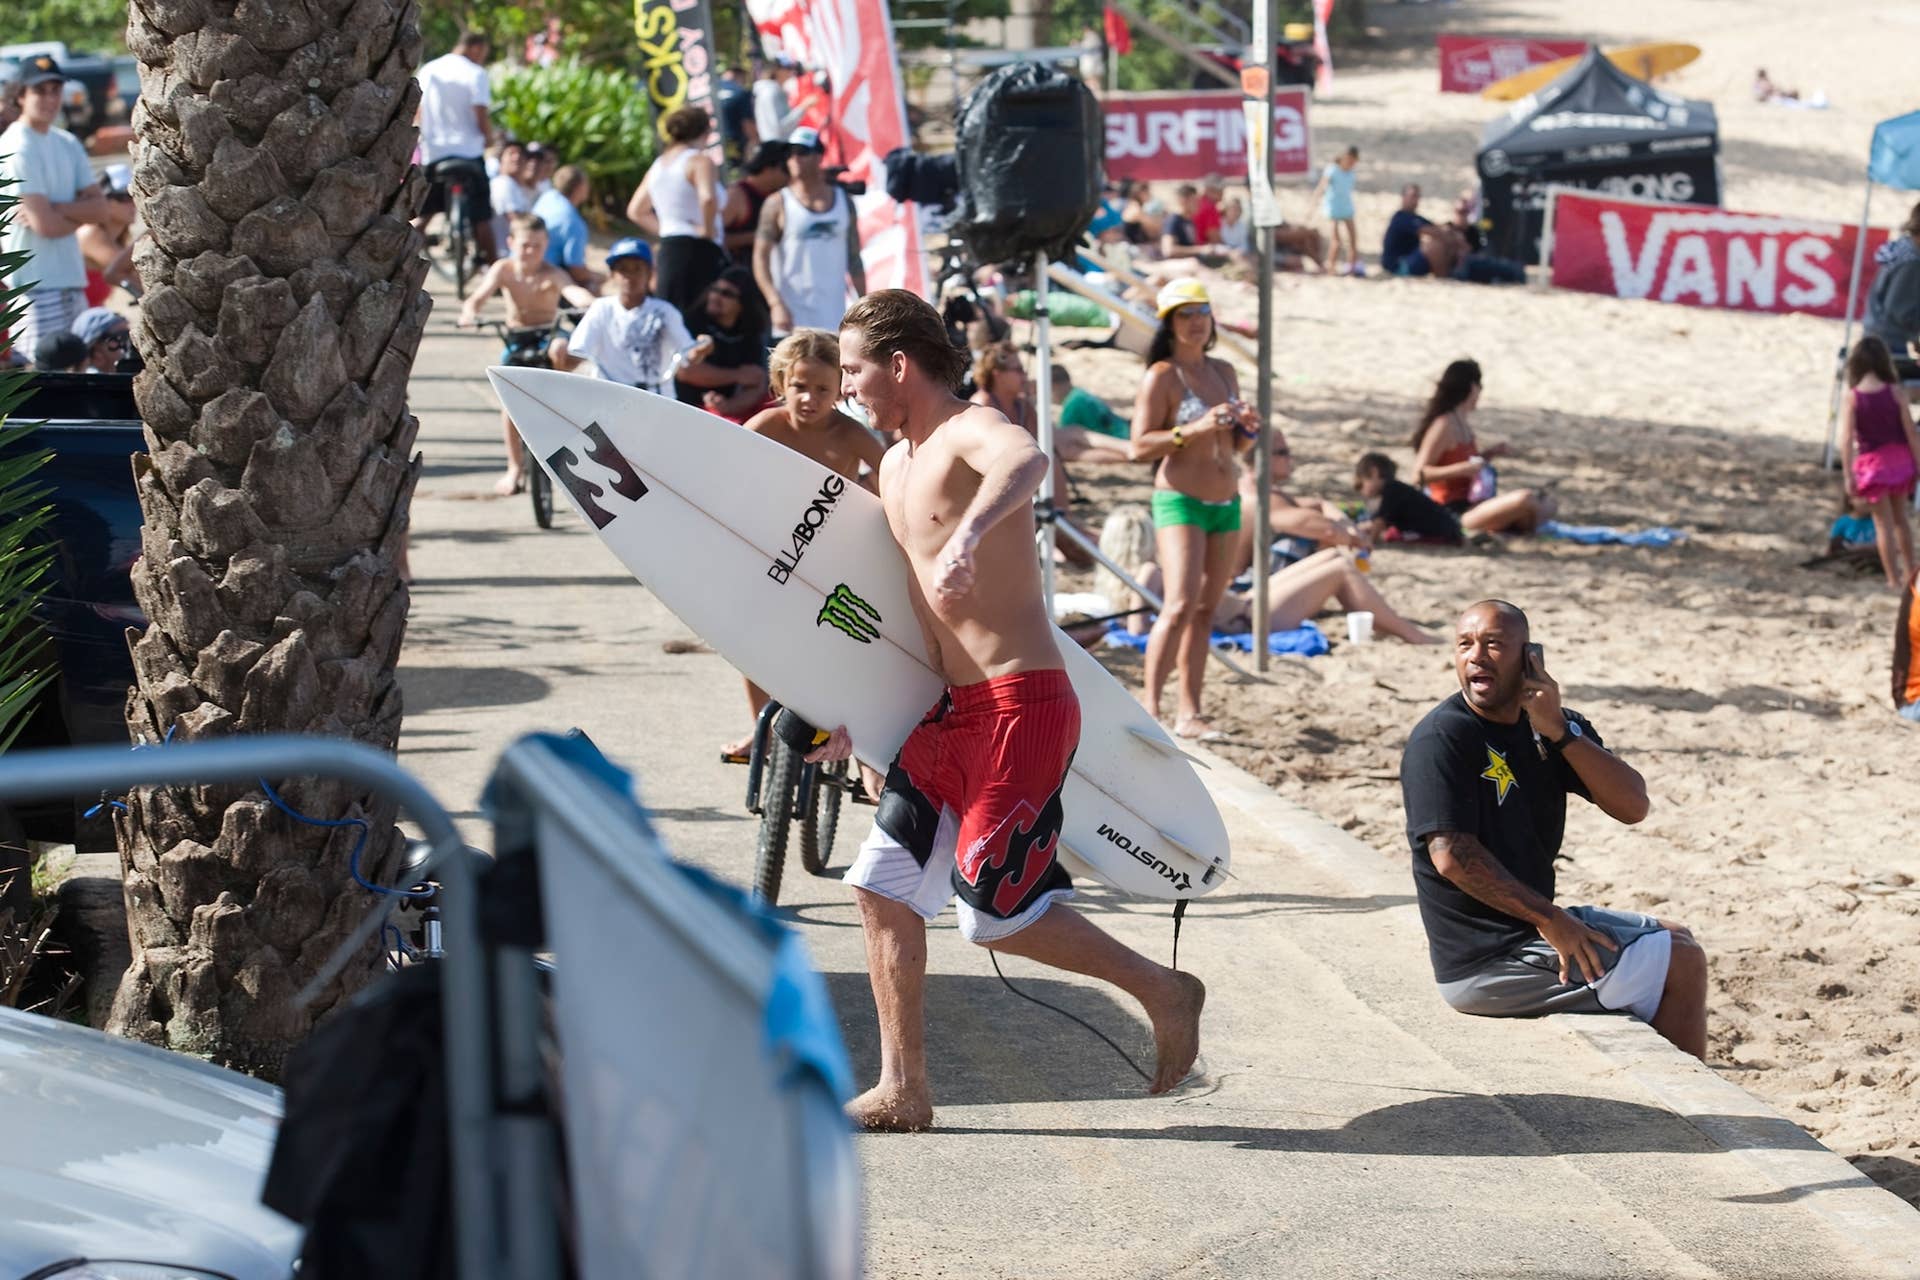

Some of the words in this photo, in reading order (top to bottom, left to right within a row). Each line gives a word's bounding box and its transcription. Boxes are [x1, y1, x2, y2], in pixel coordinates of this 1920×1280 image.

[1600, 211, 1842, 306] VANS
[767, 474, 845, 585] BILLABONG
[1096, 823, 1182, 883] KUSTOM
